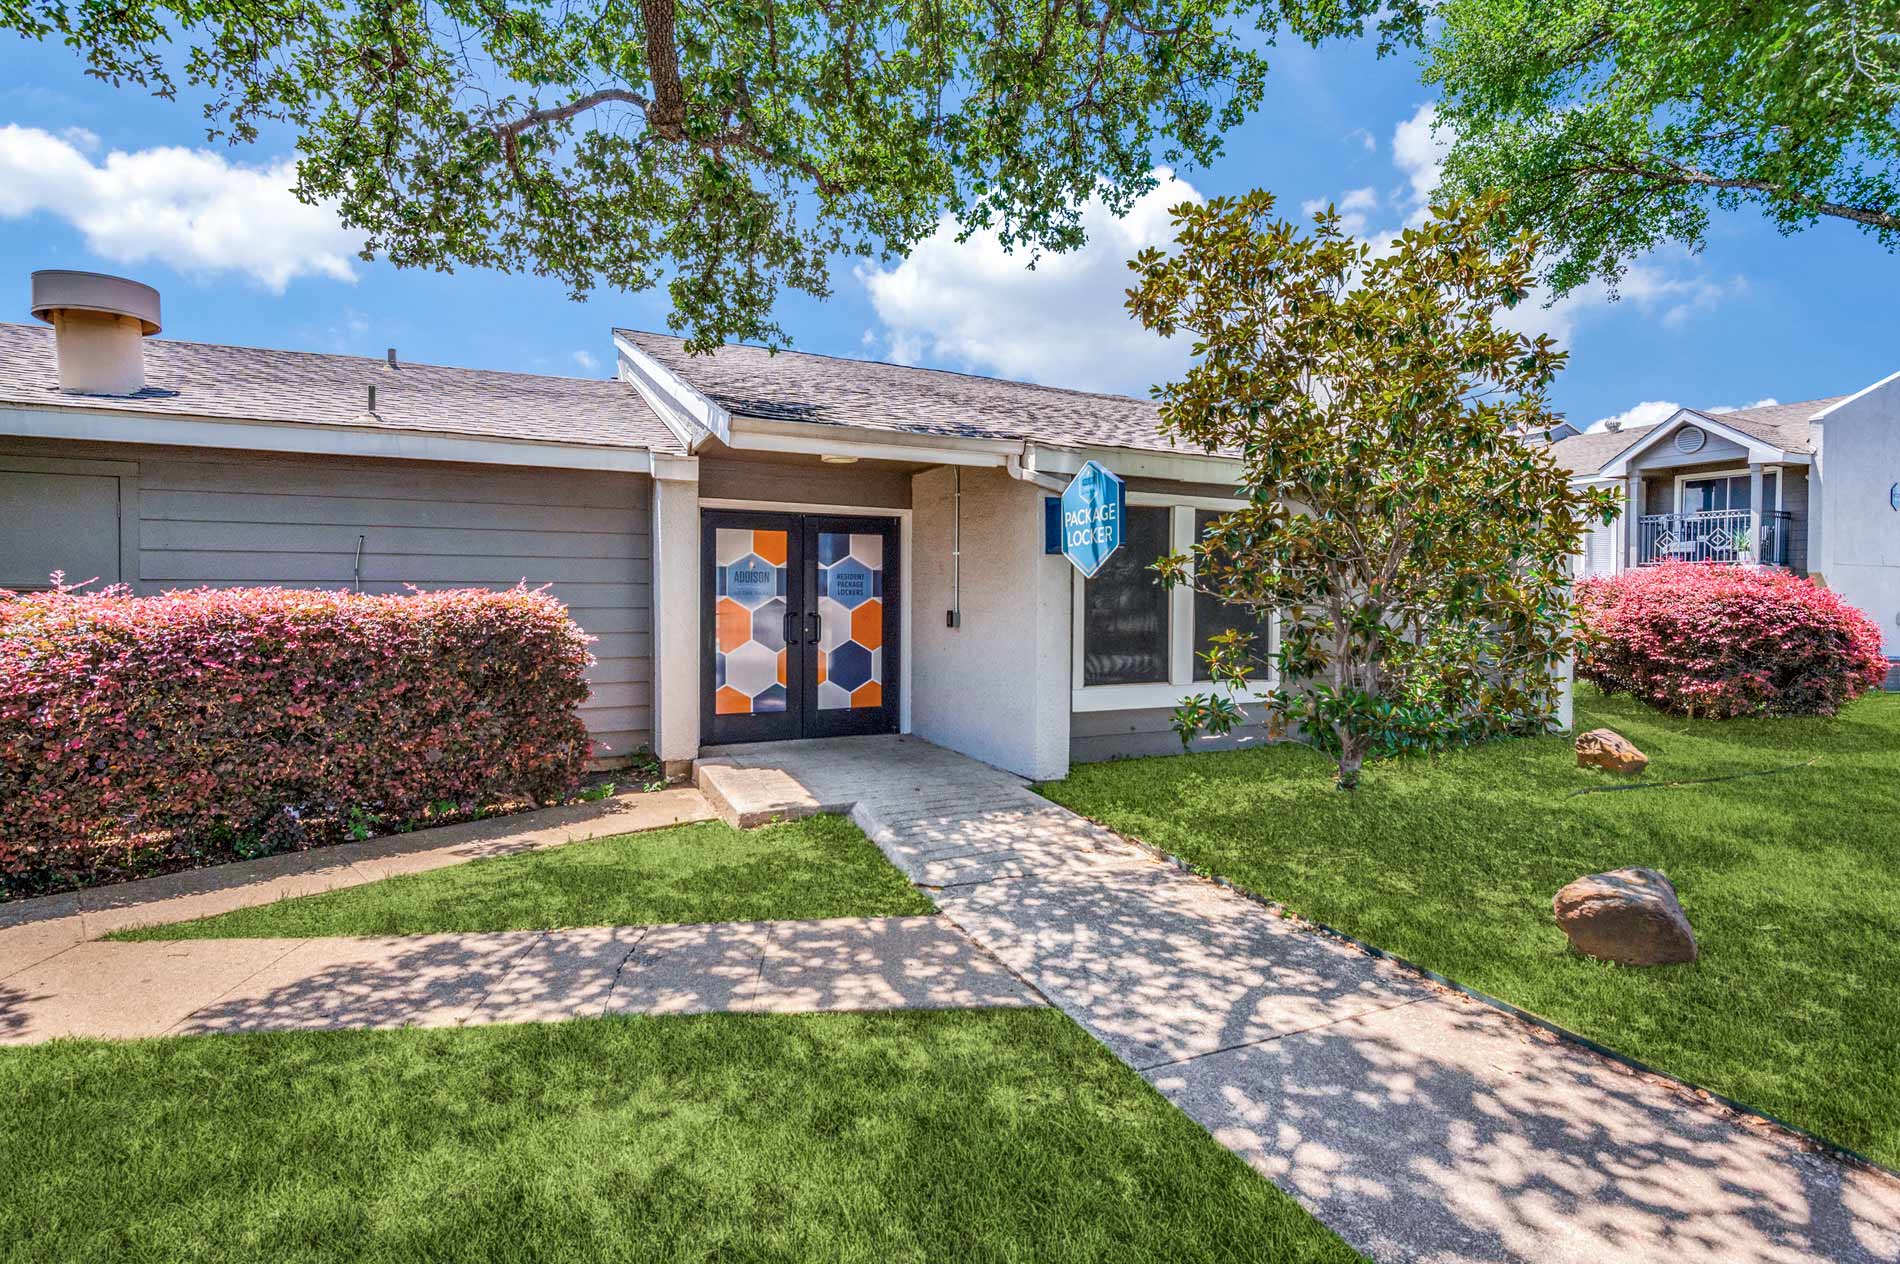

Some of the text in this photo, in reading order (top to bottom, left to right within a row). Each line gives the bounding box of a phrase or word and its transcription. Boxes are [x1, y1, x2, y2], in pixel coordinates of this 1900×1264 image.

[1065, 503, 1116, 527] PACKAGE
[1067, 526, 1112, 547] LOCKER
[734, 570, 770, 583] ADDISON
[837, 573, 865, 581] RESIDENT
[837, 588, 864, 596] LOCKERS
